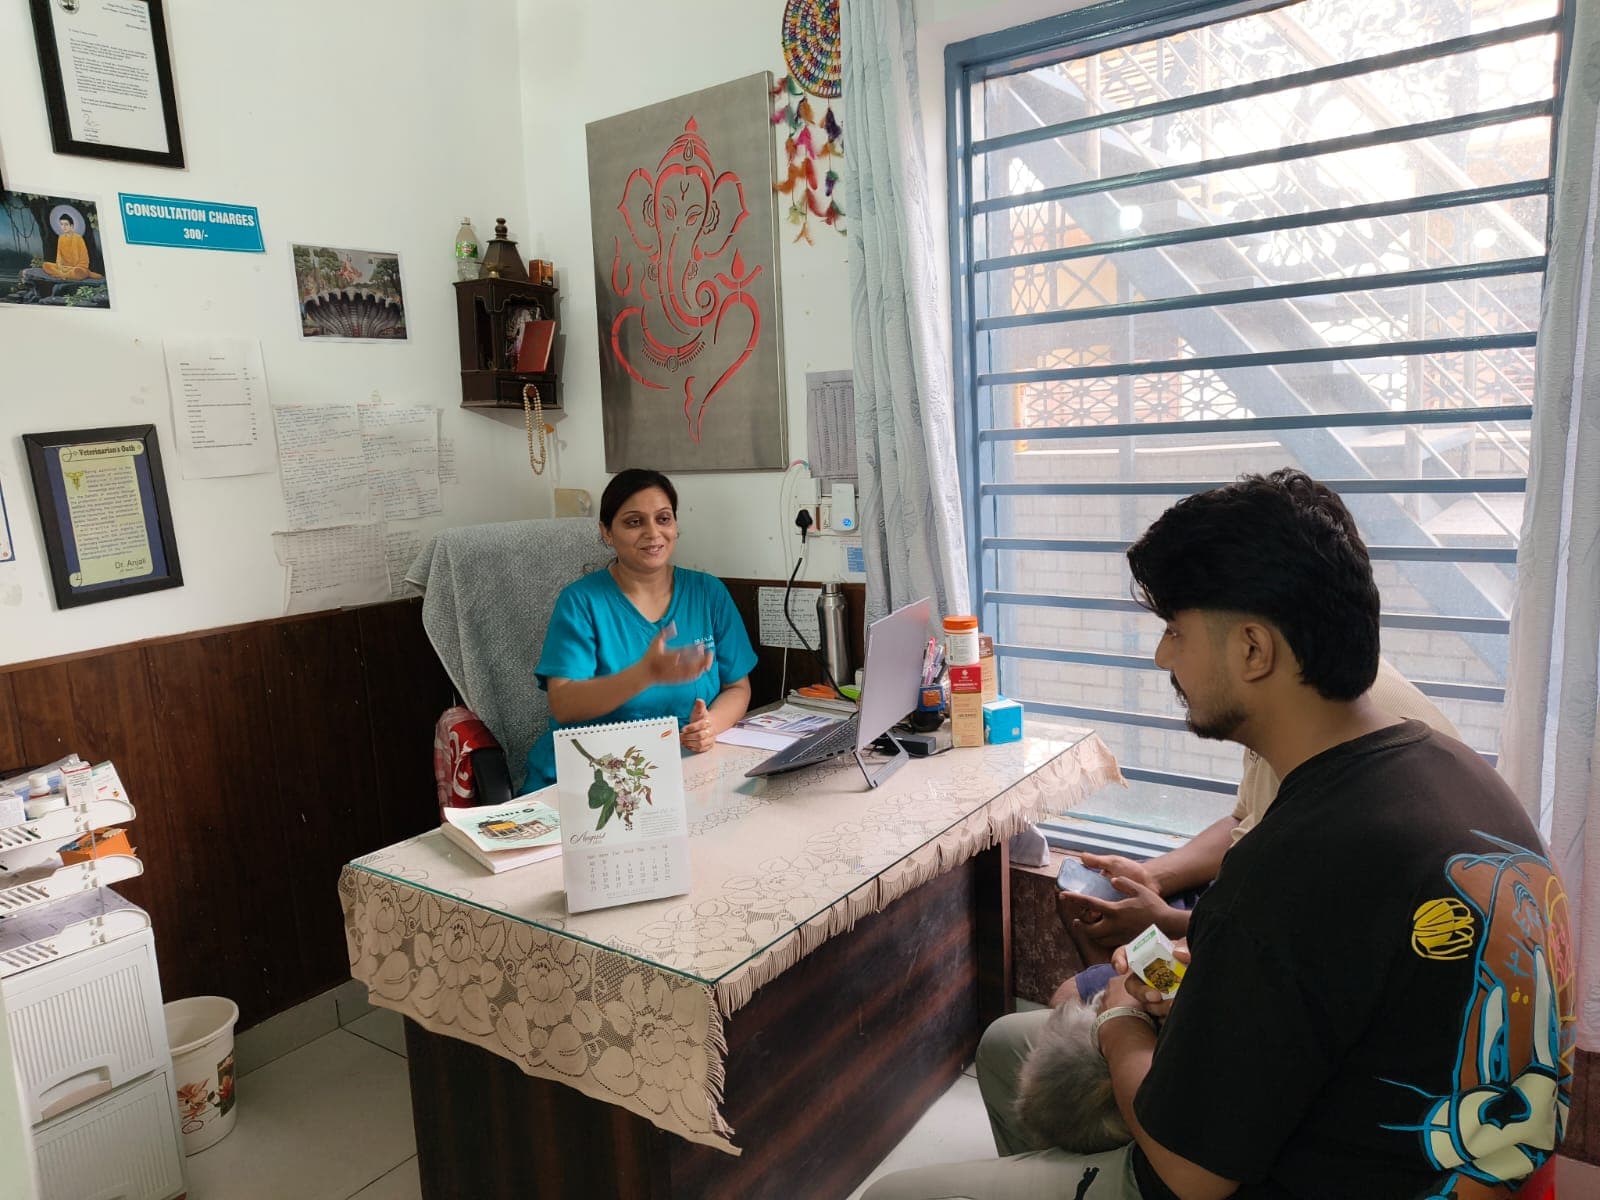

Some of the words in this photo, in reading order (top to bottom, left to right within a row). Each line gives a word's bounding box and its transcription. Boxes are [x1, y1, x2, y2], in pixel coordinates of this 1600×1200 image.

[125, 202, 206, 222] CONSULTATION
[208, 211, 255, 227] CHARGES
[183, 228, 208, 240] 300/-
[121, 444, 135, 452] Oath
